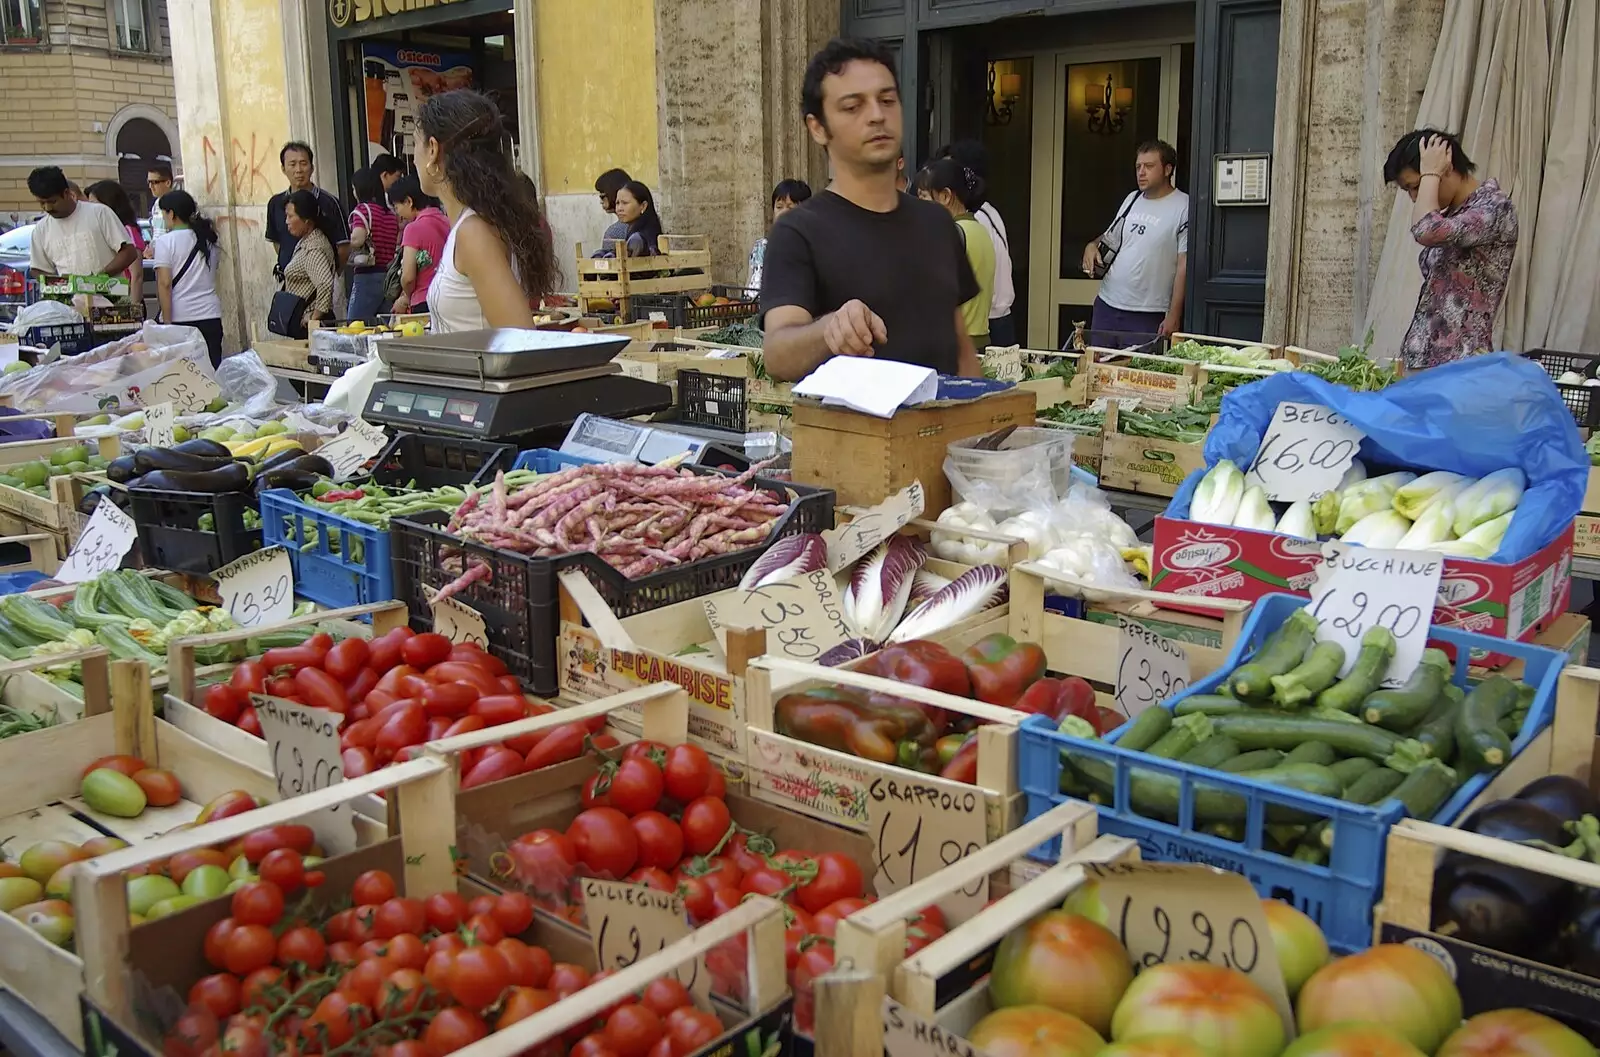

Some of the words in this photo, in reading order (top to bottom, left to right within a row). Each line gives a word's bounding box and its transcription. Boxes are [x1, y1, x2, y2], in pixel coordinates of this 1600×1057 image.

[1130, 223, 1146, 235] 78
[180, 357, 215, 389] ABATE
[1282, 405, 1354, 426] BELG
[634, 650, 732, 710] CAMBISE
[251, 696, 334, 738] PANTANO
[869, 777, 977, 813] GRAPPOLO
[586, 882, 681, 916] CILIEGINE
